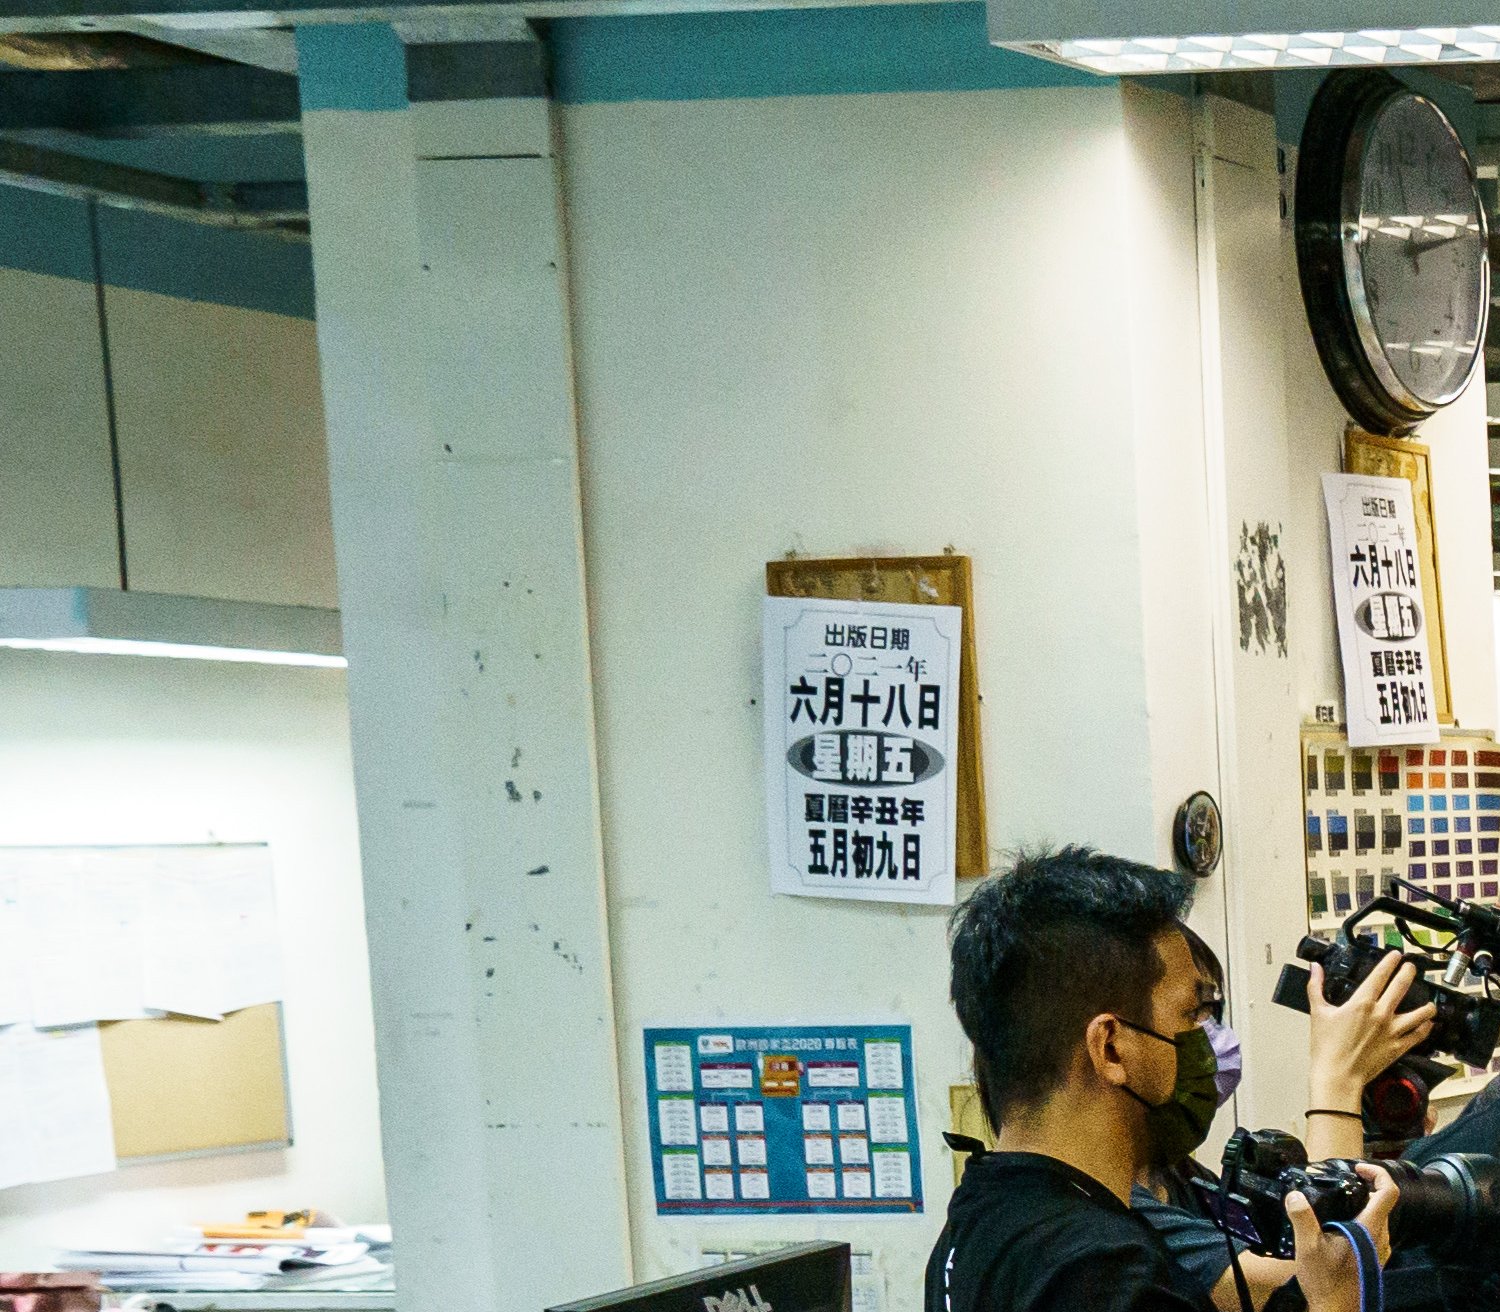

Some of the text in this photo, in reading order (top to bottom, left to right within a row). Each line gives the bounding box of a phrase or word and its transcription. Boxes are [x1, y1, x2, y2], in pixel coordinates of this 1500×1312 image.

[1361, 496, 1397, 519] 出版日期
[1350, 544, 1416, 588] 六月十八日
[825, 623, 910, 651] 出版日期
[1369, 595, 1416, 638] 星期五
[789, 675, 941, 730] 六月十八日
[1376, 681, 1428, 725] 五月初九日
[812, 733, 915, 783] 星期五
[808, 828, 921, 880] 五月初九日
